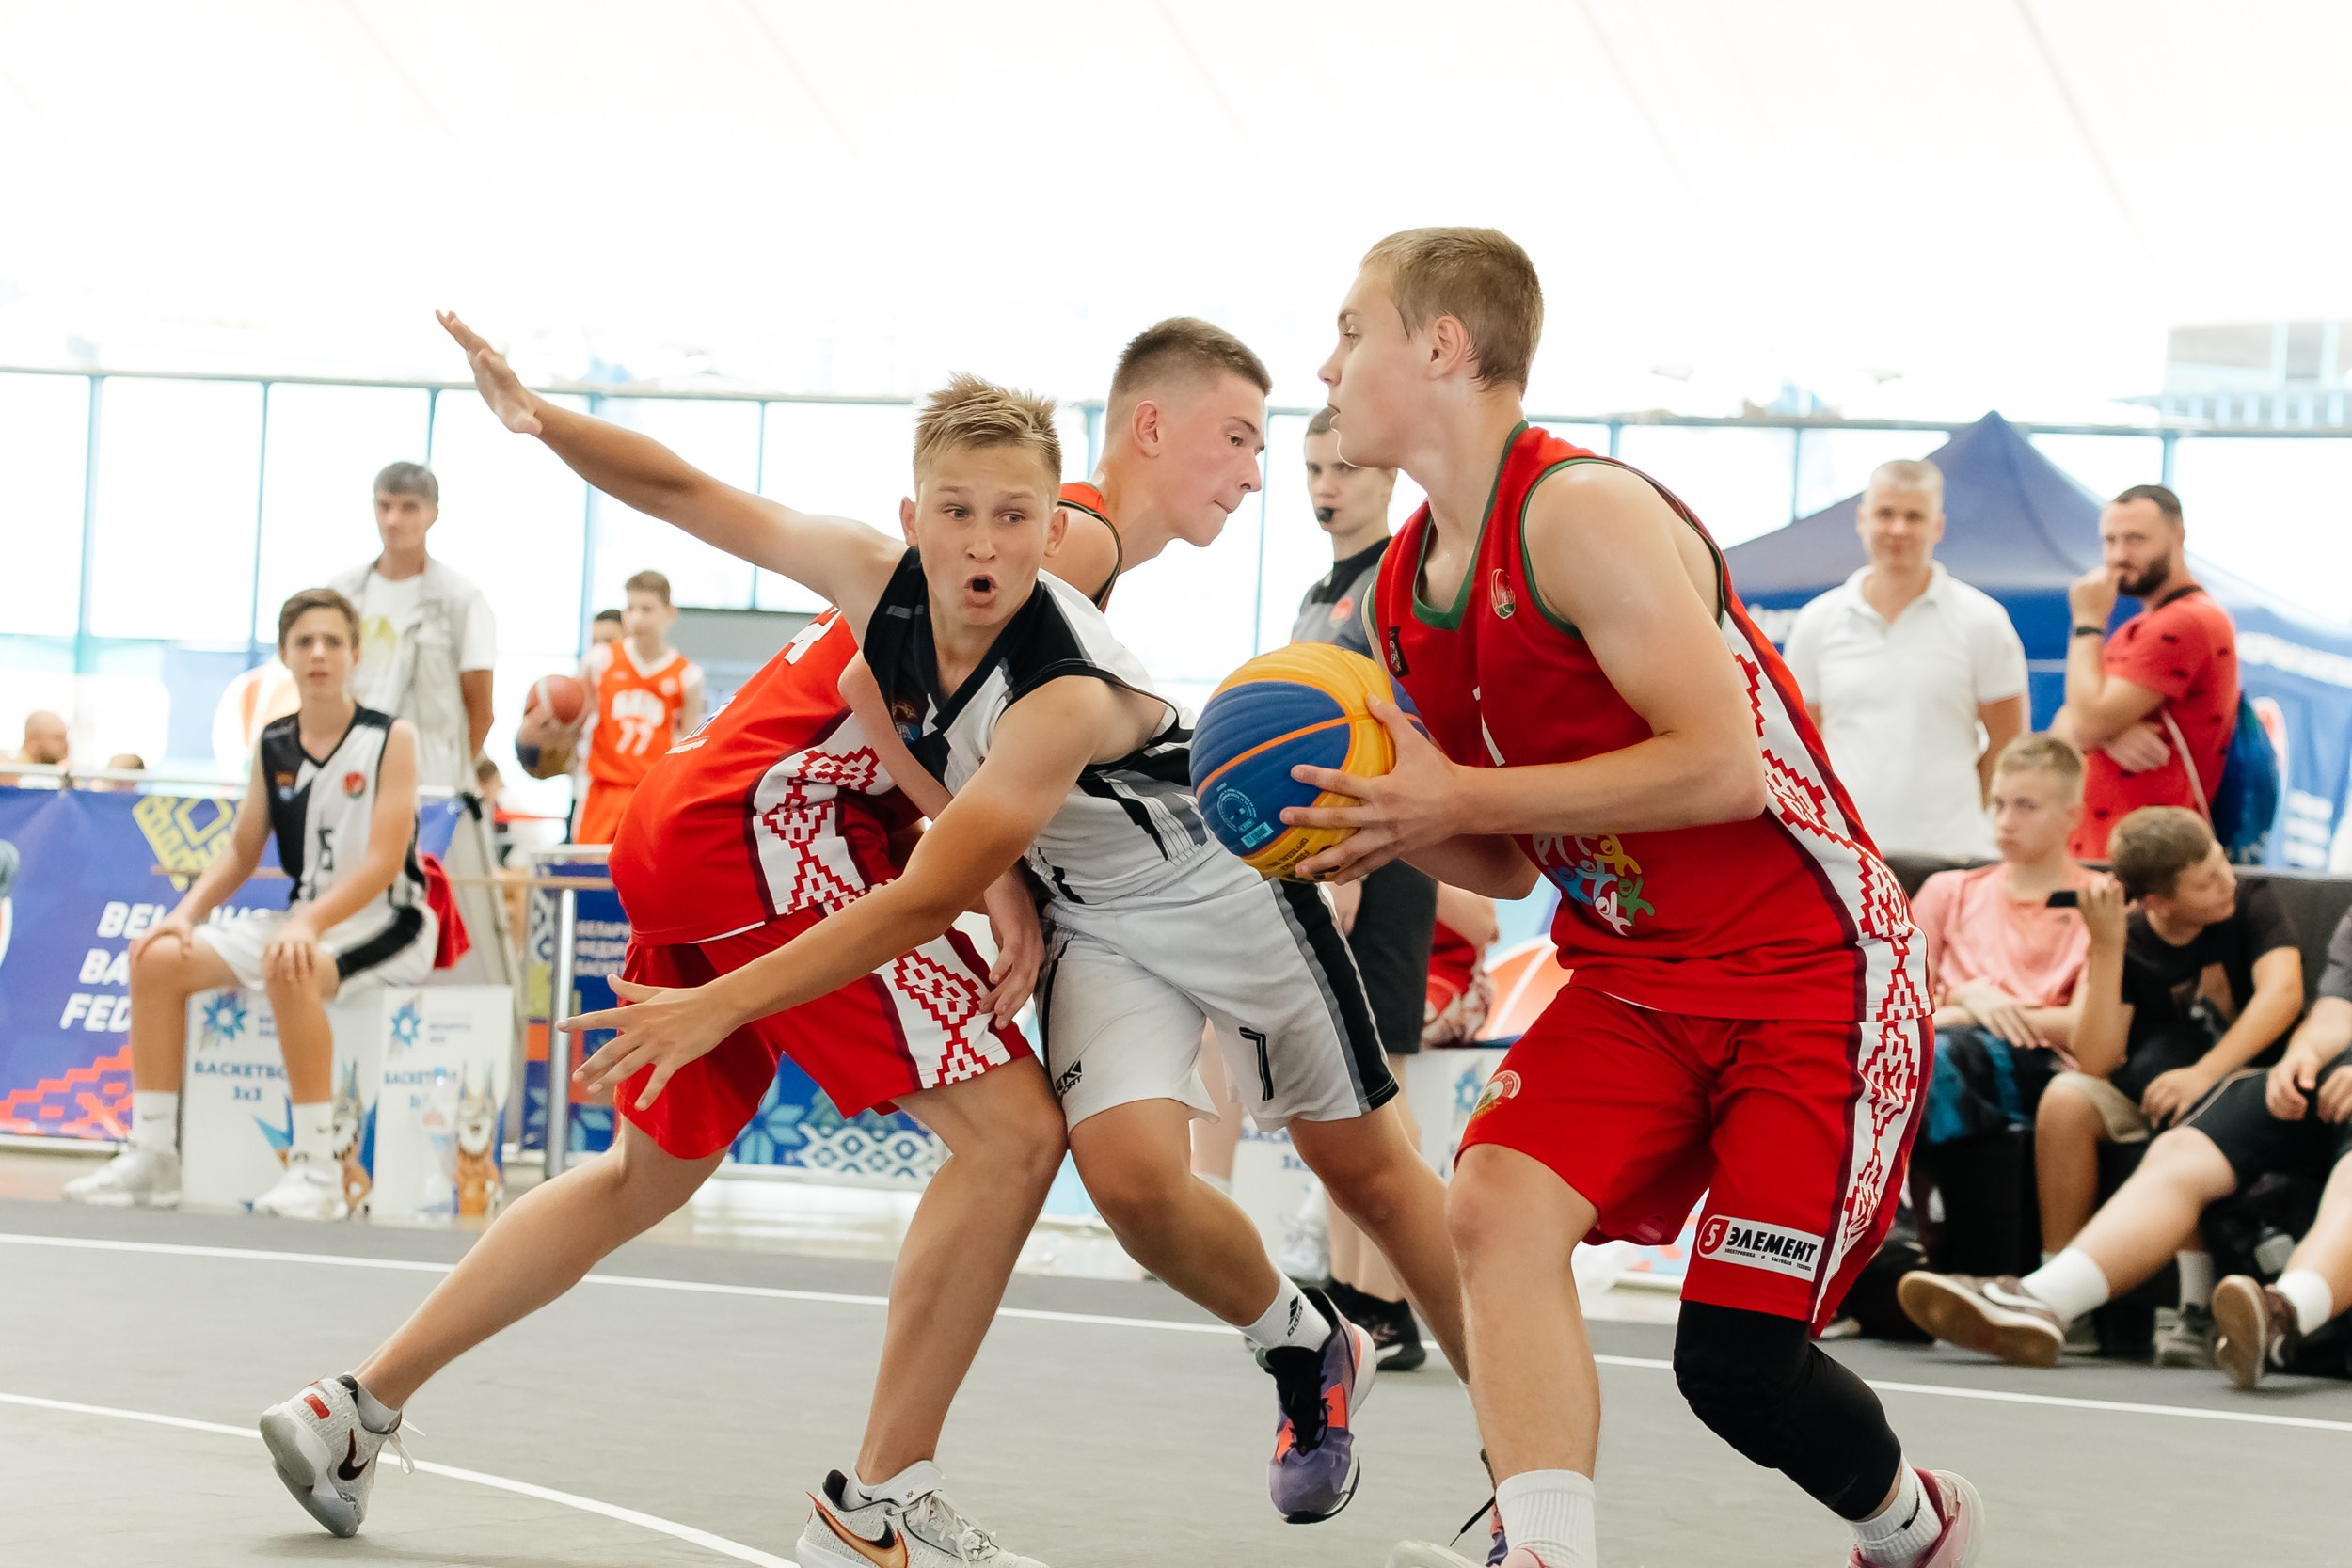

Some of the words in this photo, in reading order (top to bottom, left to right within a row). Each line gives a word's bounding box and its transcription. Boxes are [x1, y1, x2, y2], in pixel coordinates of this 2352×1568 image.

[618, 720, 656, 756] 77
[1238, 1026, 1275, 1101] 7
[1704, 1224, 1721, 1247] 5
[1726, 1227, 1818, 1263] ЭЛЕМЕНТ
